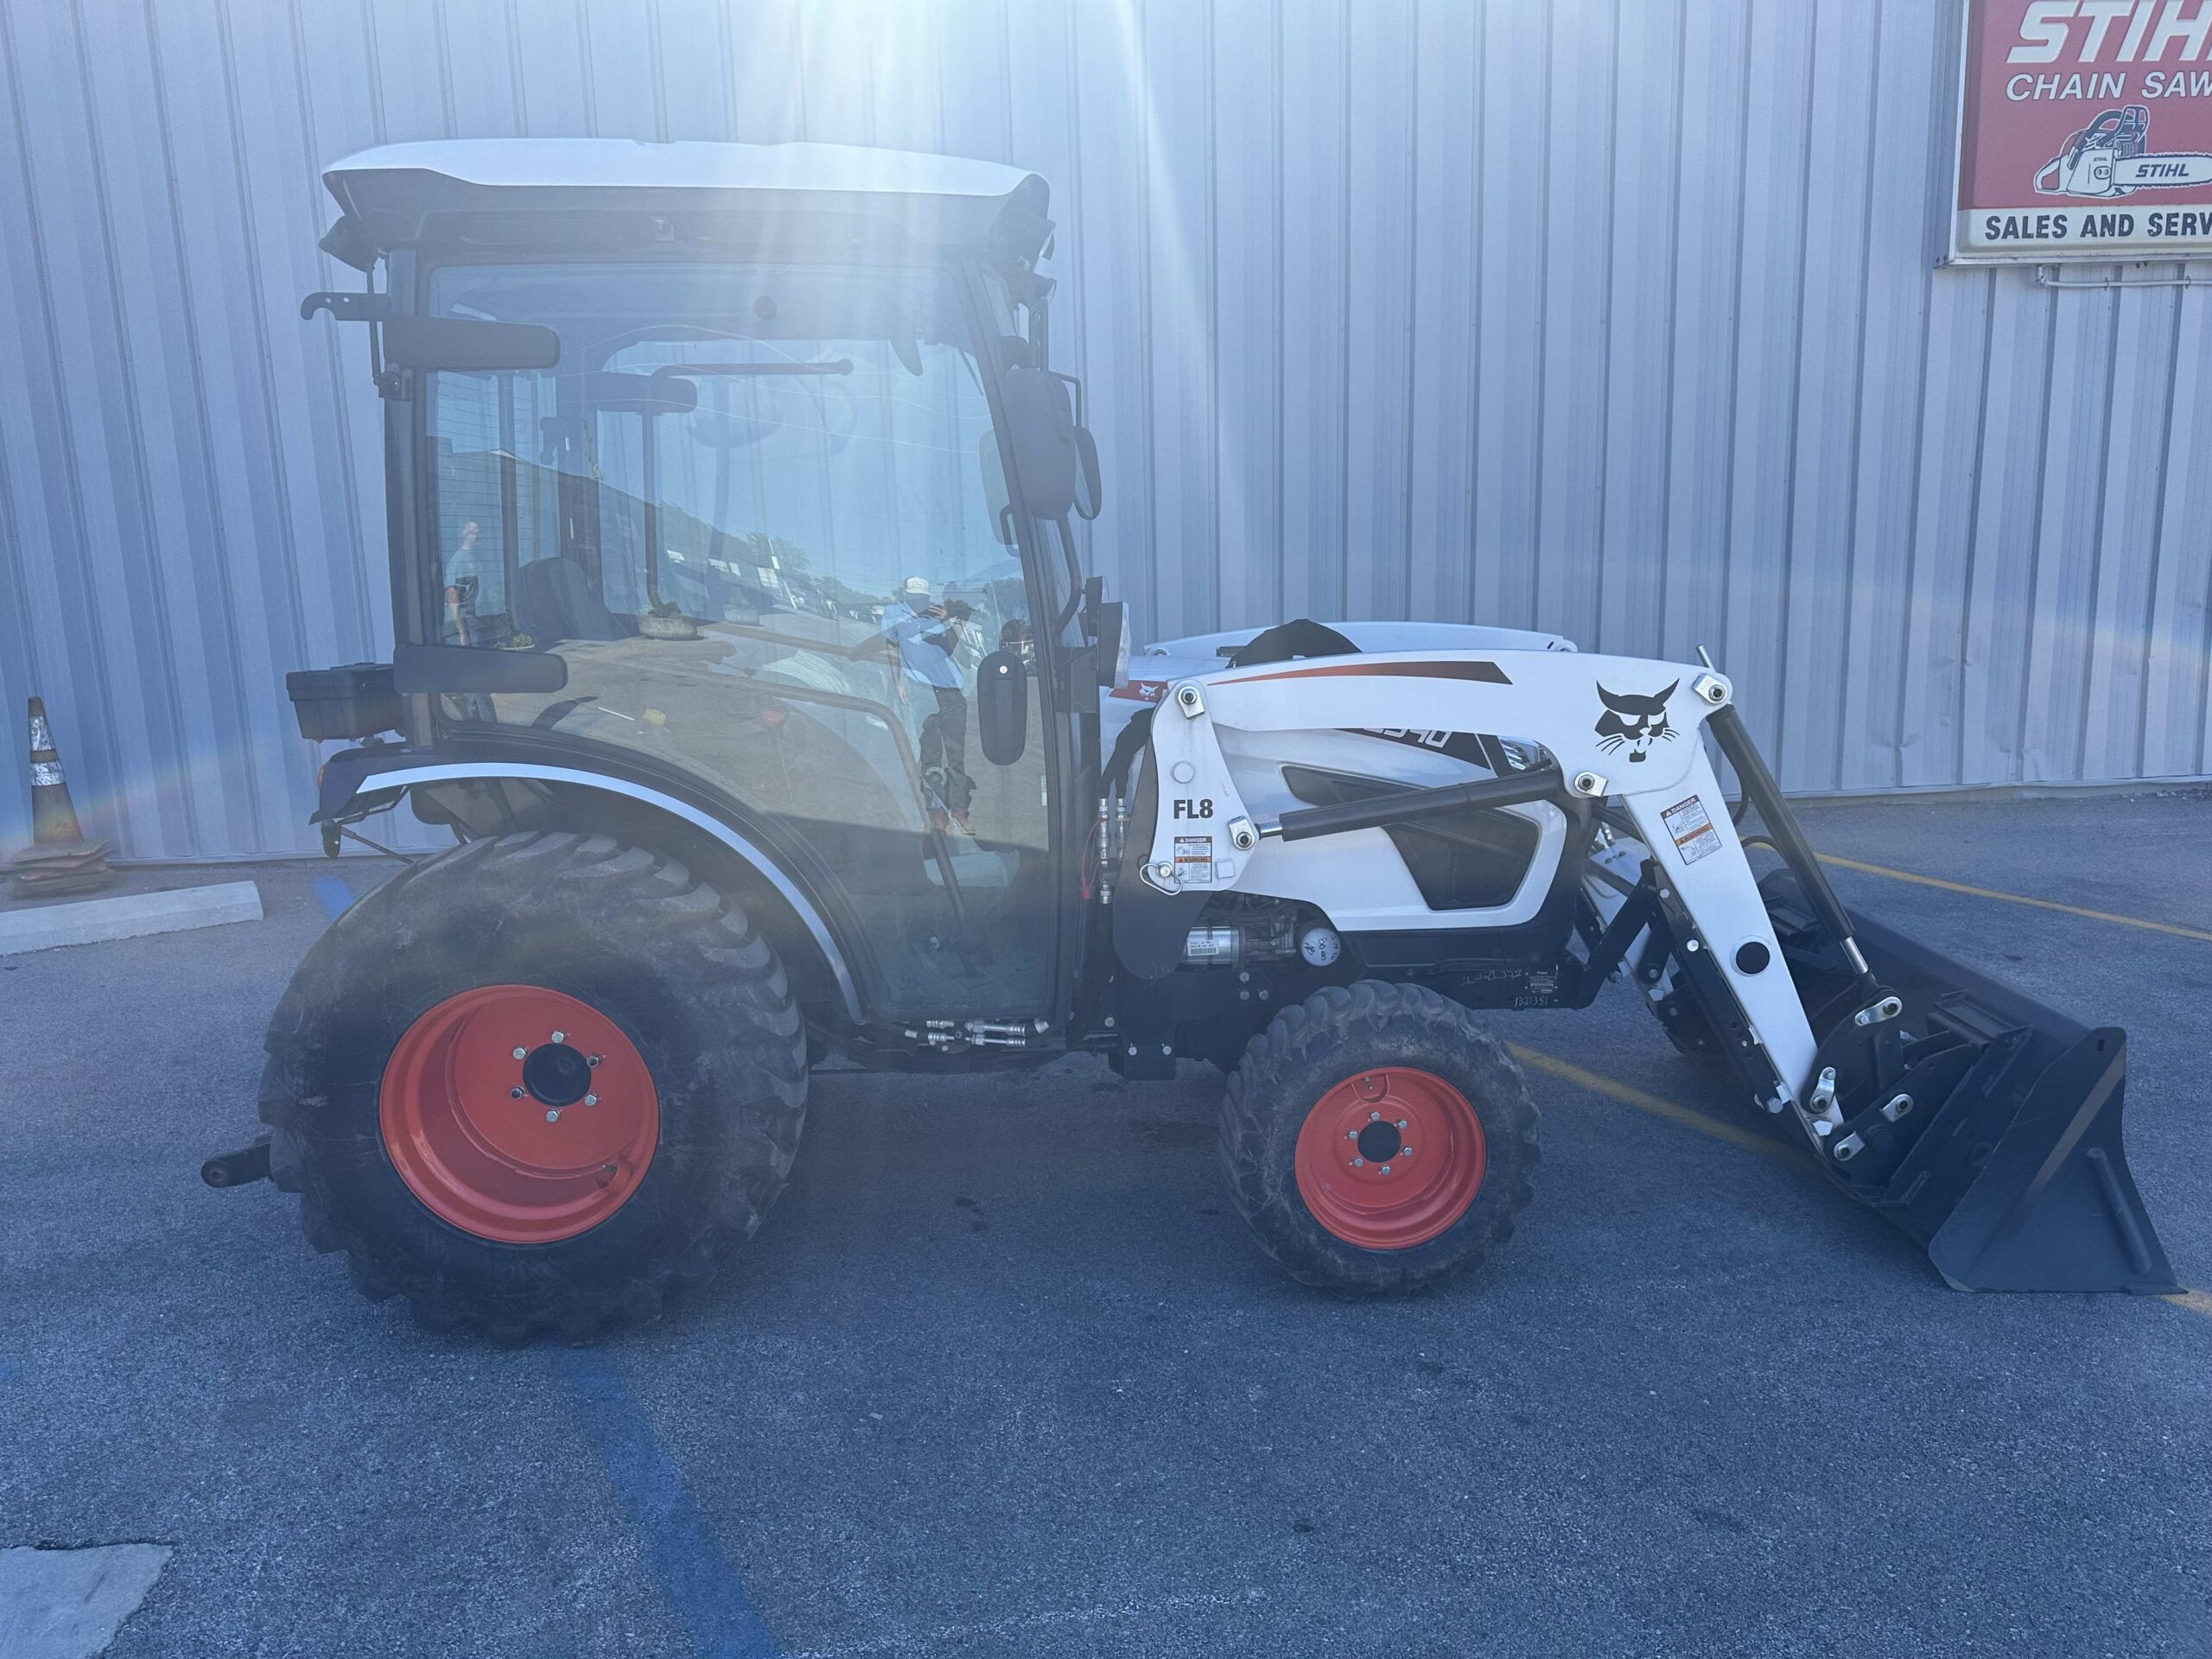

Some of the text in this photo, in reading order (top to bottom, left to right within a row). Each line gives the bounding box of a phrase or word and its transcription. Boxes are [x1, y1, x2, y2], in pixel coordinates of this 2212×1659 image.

[2005, 0, 2212, 63] STIH
[2005, 70, 2212, 101] CHAIN SAW
[2135, 163, 2190, 178] STIHL
[1985, 213, 2212, 240] SALES AND SERV
[1173, 798, 1213, 819] FL8
[1671, 798, 1696, 814] DANGER
